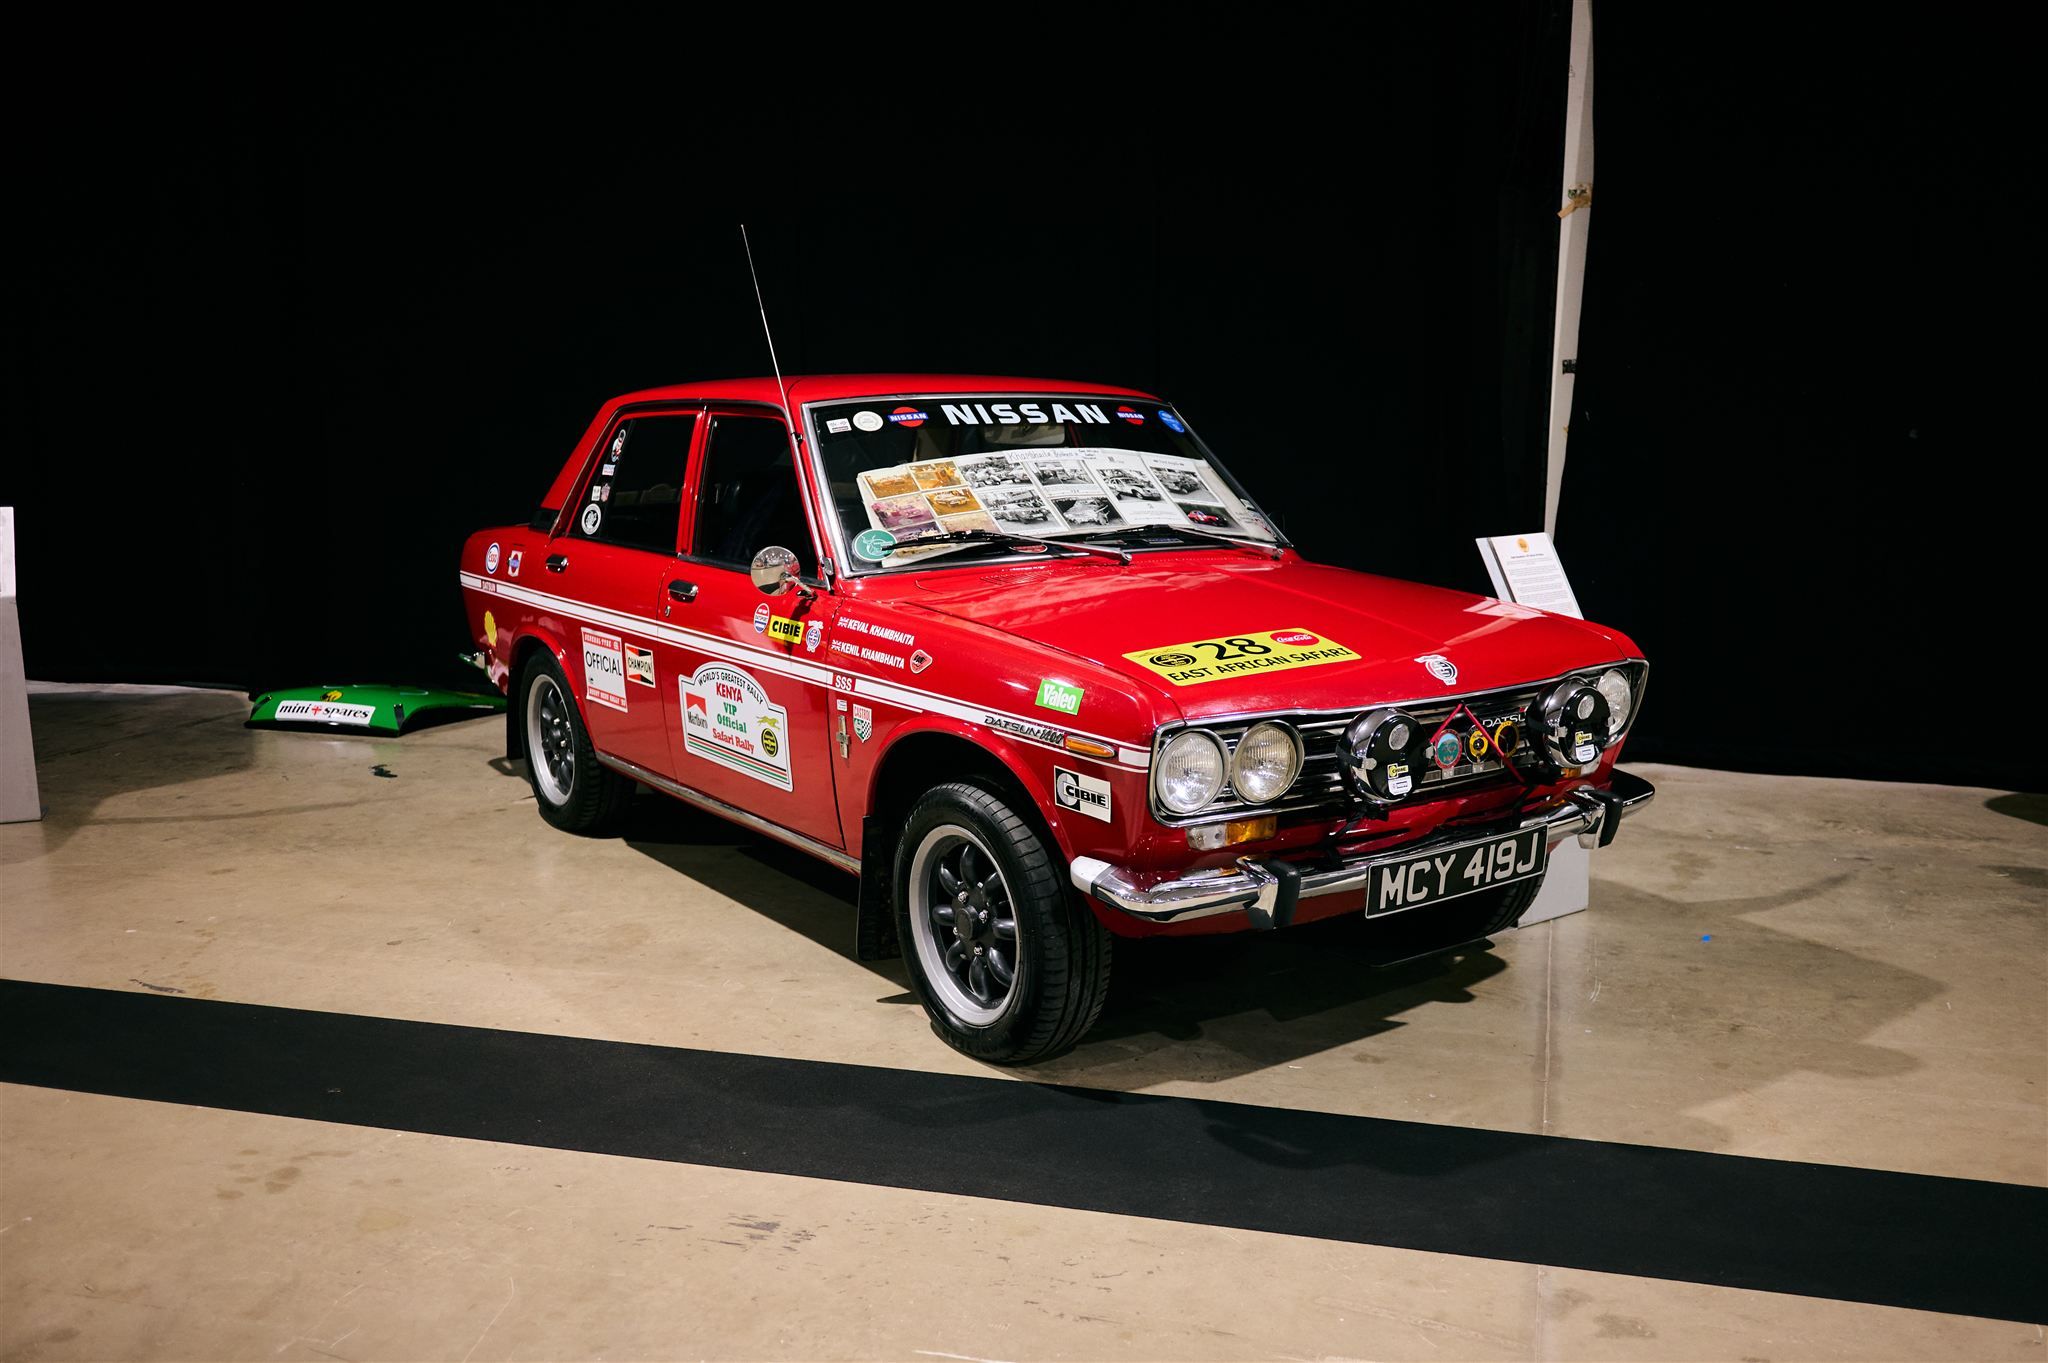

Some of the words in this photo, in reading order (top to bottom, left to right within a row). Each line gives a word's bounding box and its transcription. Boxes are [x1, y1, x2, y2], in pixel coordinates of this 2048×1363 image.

[890, 412, 928, 422] NISSAN
[940, 403, 1110, 426] NISSAN
[1117, 411, 1145, 420] NISSAN
[846, 619, 869, 634] KEVAL
[869, 624, 915, 647] KHAMBHAITA
[840, 641, 860, 657] KENIL
[860, 647, 905, 670] KHAMBHAITA
[1192, 637, 1273, 661] 28
[585, 650, 622, 677] OFFICIAL
[628, 656, 652, 674] CHAMPION
[1167, 667, 1216, 682] EAST
[1215, 655, 1294, 675] AFRICAN
[1292, 647, 1353, 663] SAFARI
[697, 671, 720, 687] WORLD'S
[720, 671, 746, 689] GREATEST
[746, 683, 764, 705] RALLY
[715, 682, 743, 704] KENYA
[835, 675, 852, 691] SSS
[1043, 683, 1078, 711] Valeo
[279, 703, 312, 714] mini
[324, 706, 369, 719] spares
[723, 702, 738, 716] VIP
[716, 714, 747, 734] Official
[984, 715, 1041, 738] DATSUN
[712, 728, 735, 746] Safari
[735, 734, 755, 754] Rally
[1379, 853, 1458, 910] MCY
[1463, 832, 1538, 887] 419J
